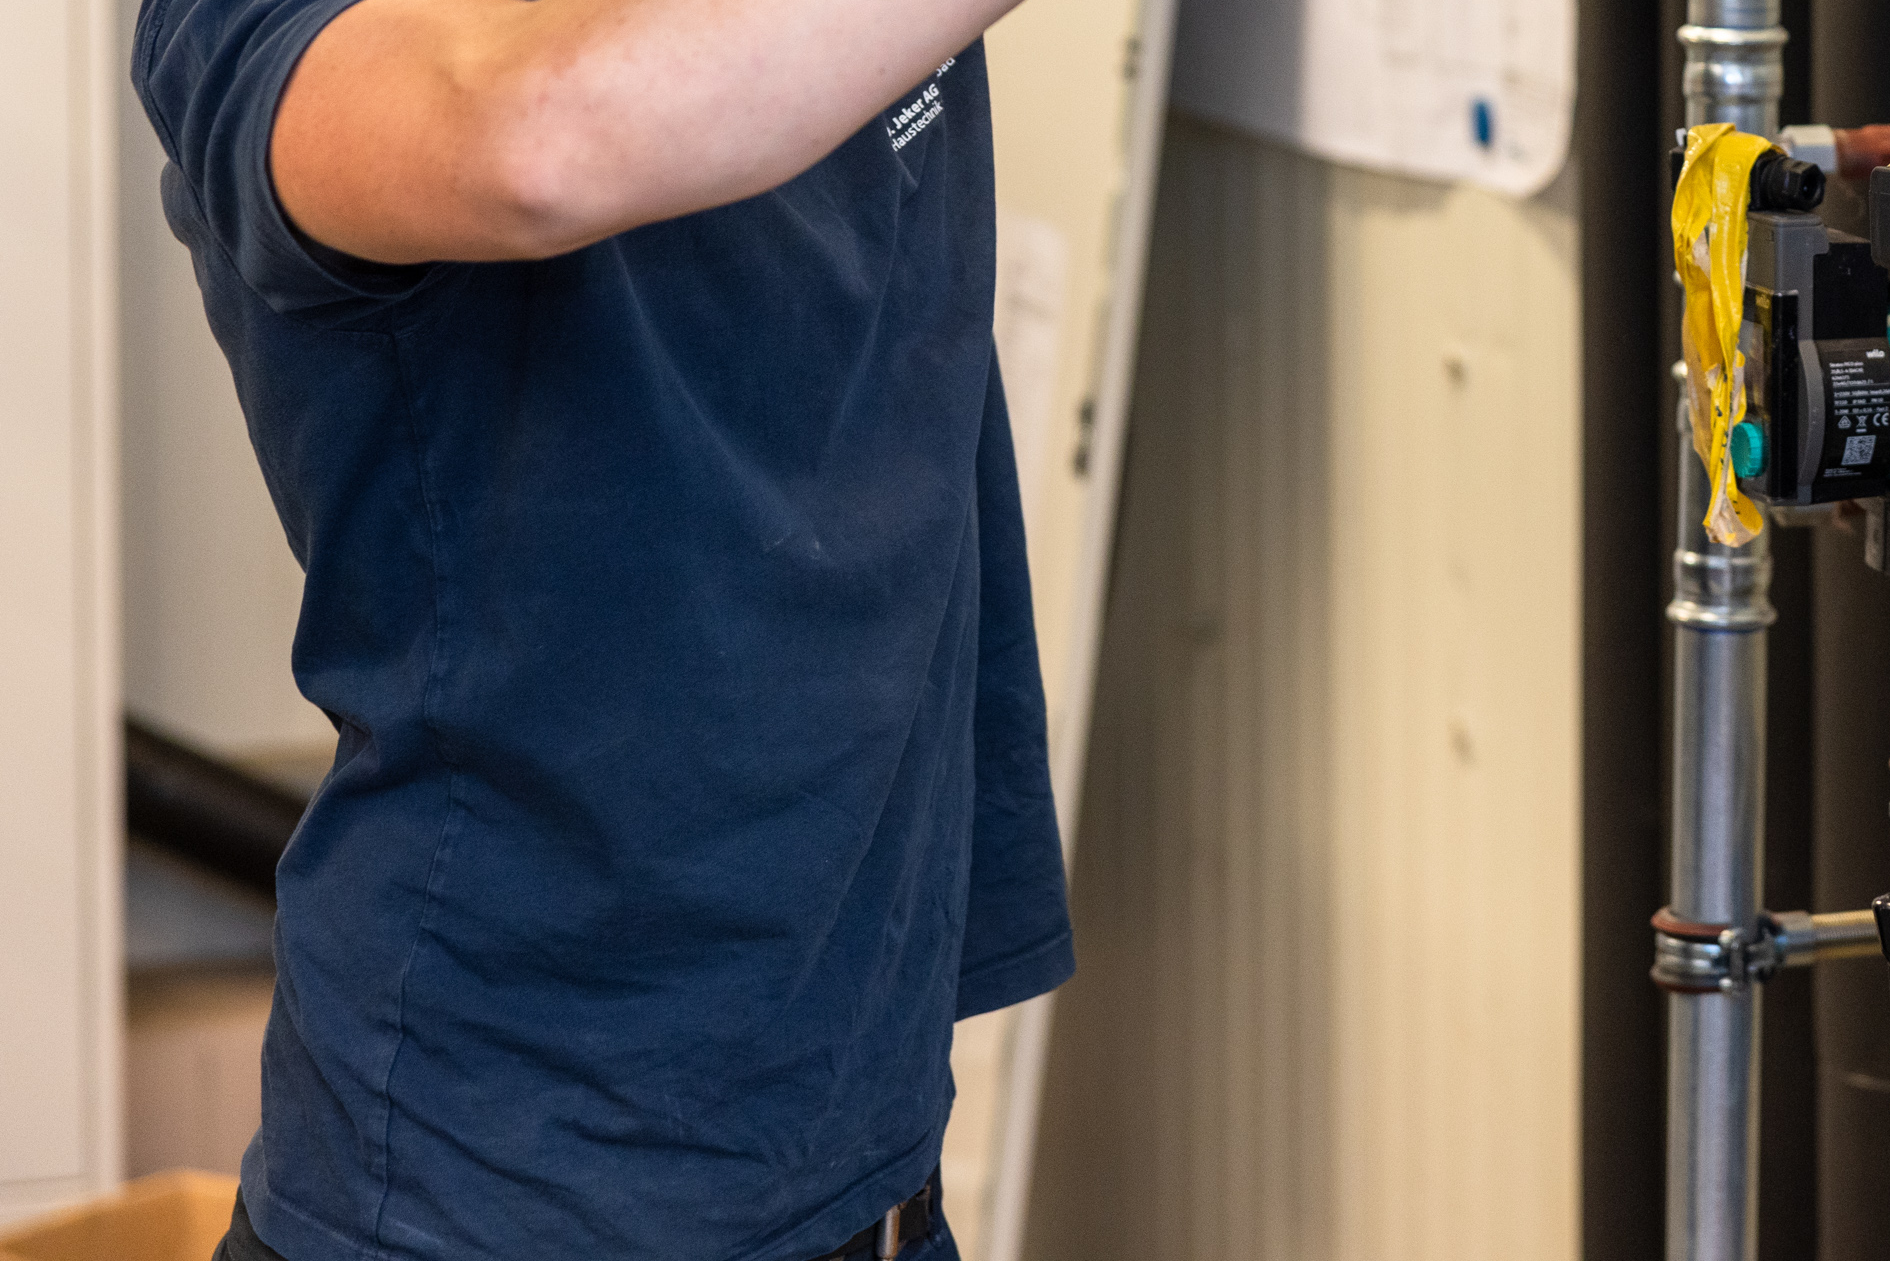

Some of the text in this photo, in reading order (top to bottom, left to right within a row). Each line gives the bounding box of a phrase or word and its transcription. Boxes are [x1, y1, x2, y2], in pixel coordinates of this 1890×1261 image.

[891, 98, 925, 131] Jeker
[922, 83, 940, 104] AG
[891, 99, 945, 152] Haustechnik
[1865, 349, 1886, 359] wilo
